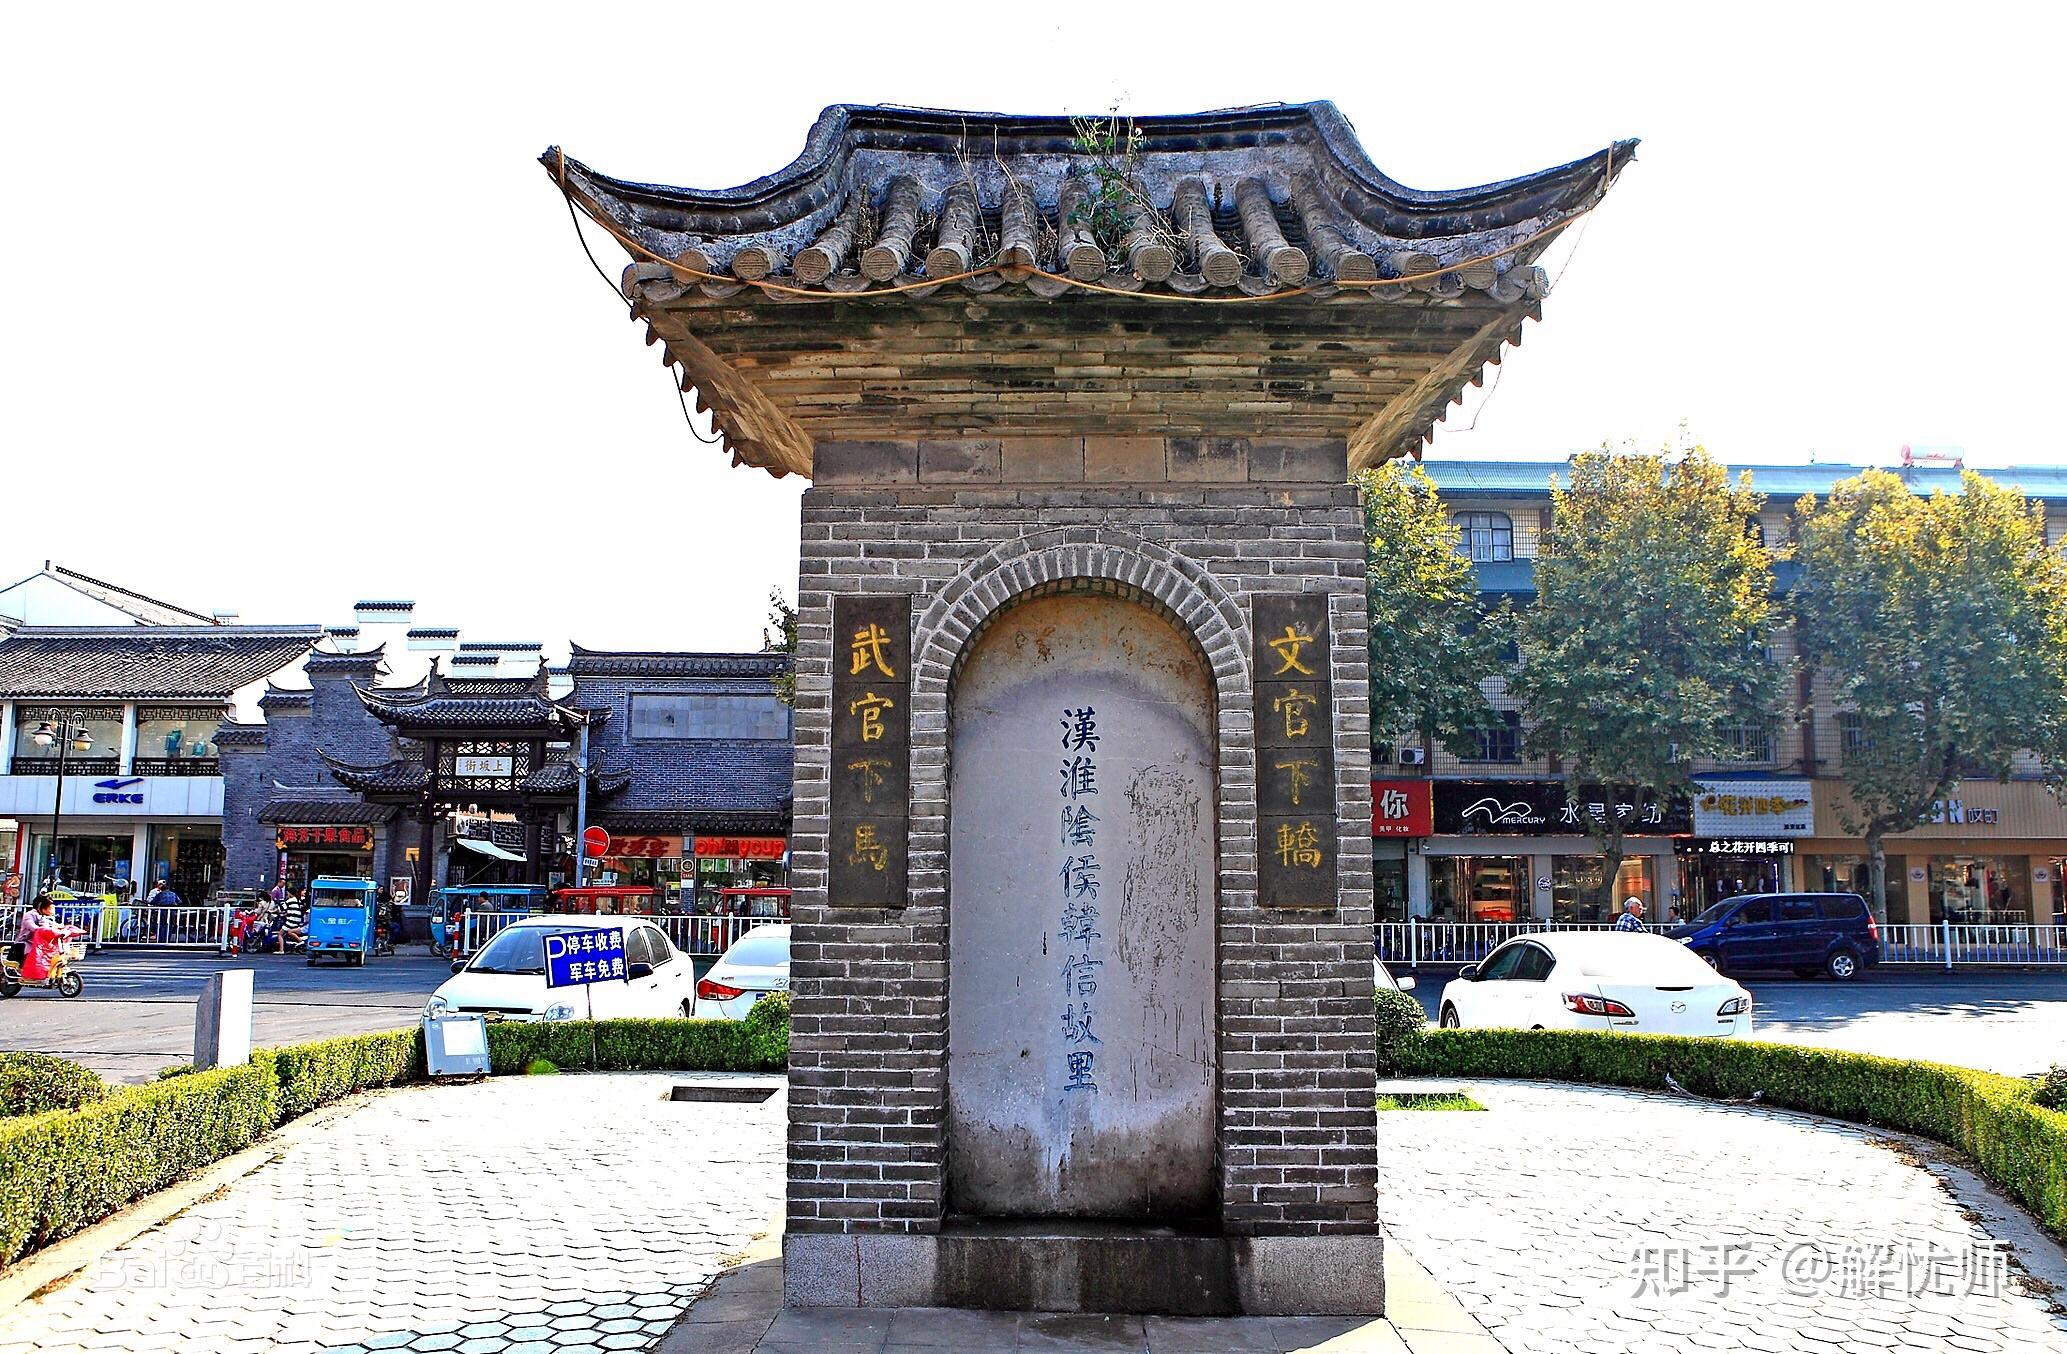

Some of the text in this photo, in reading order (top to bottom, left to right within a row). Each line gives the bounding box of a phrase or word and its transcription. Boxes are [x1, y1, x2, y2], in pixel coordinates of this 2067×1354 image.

[849, 622, 895, 871] 武官下馬
[1268, 625, 1322, 869] 文官下轎
[92, 792, 144, 804] ERKE
[1380, 789, 1410, 819] 你
[1502, 816, 1546, 825] MERCURY
[1709, 840, 1795, 854] 总之花开四季可
[567, 930, 622, 956] 停车收费
[569, 956, 625, 982] 军车免费
